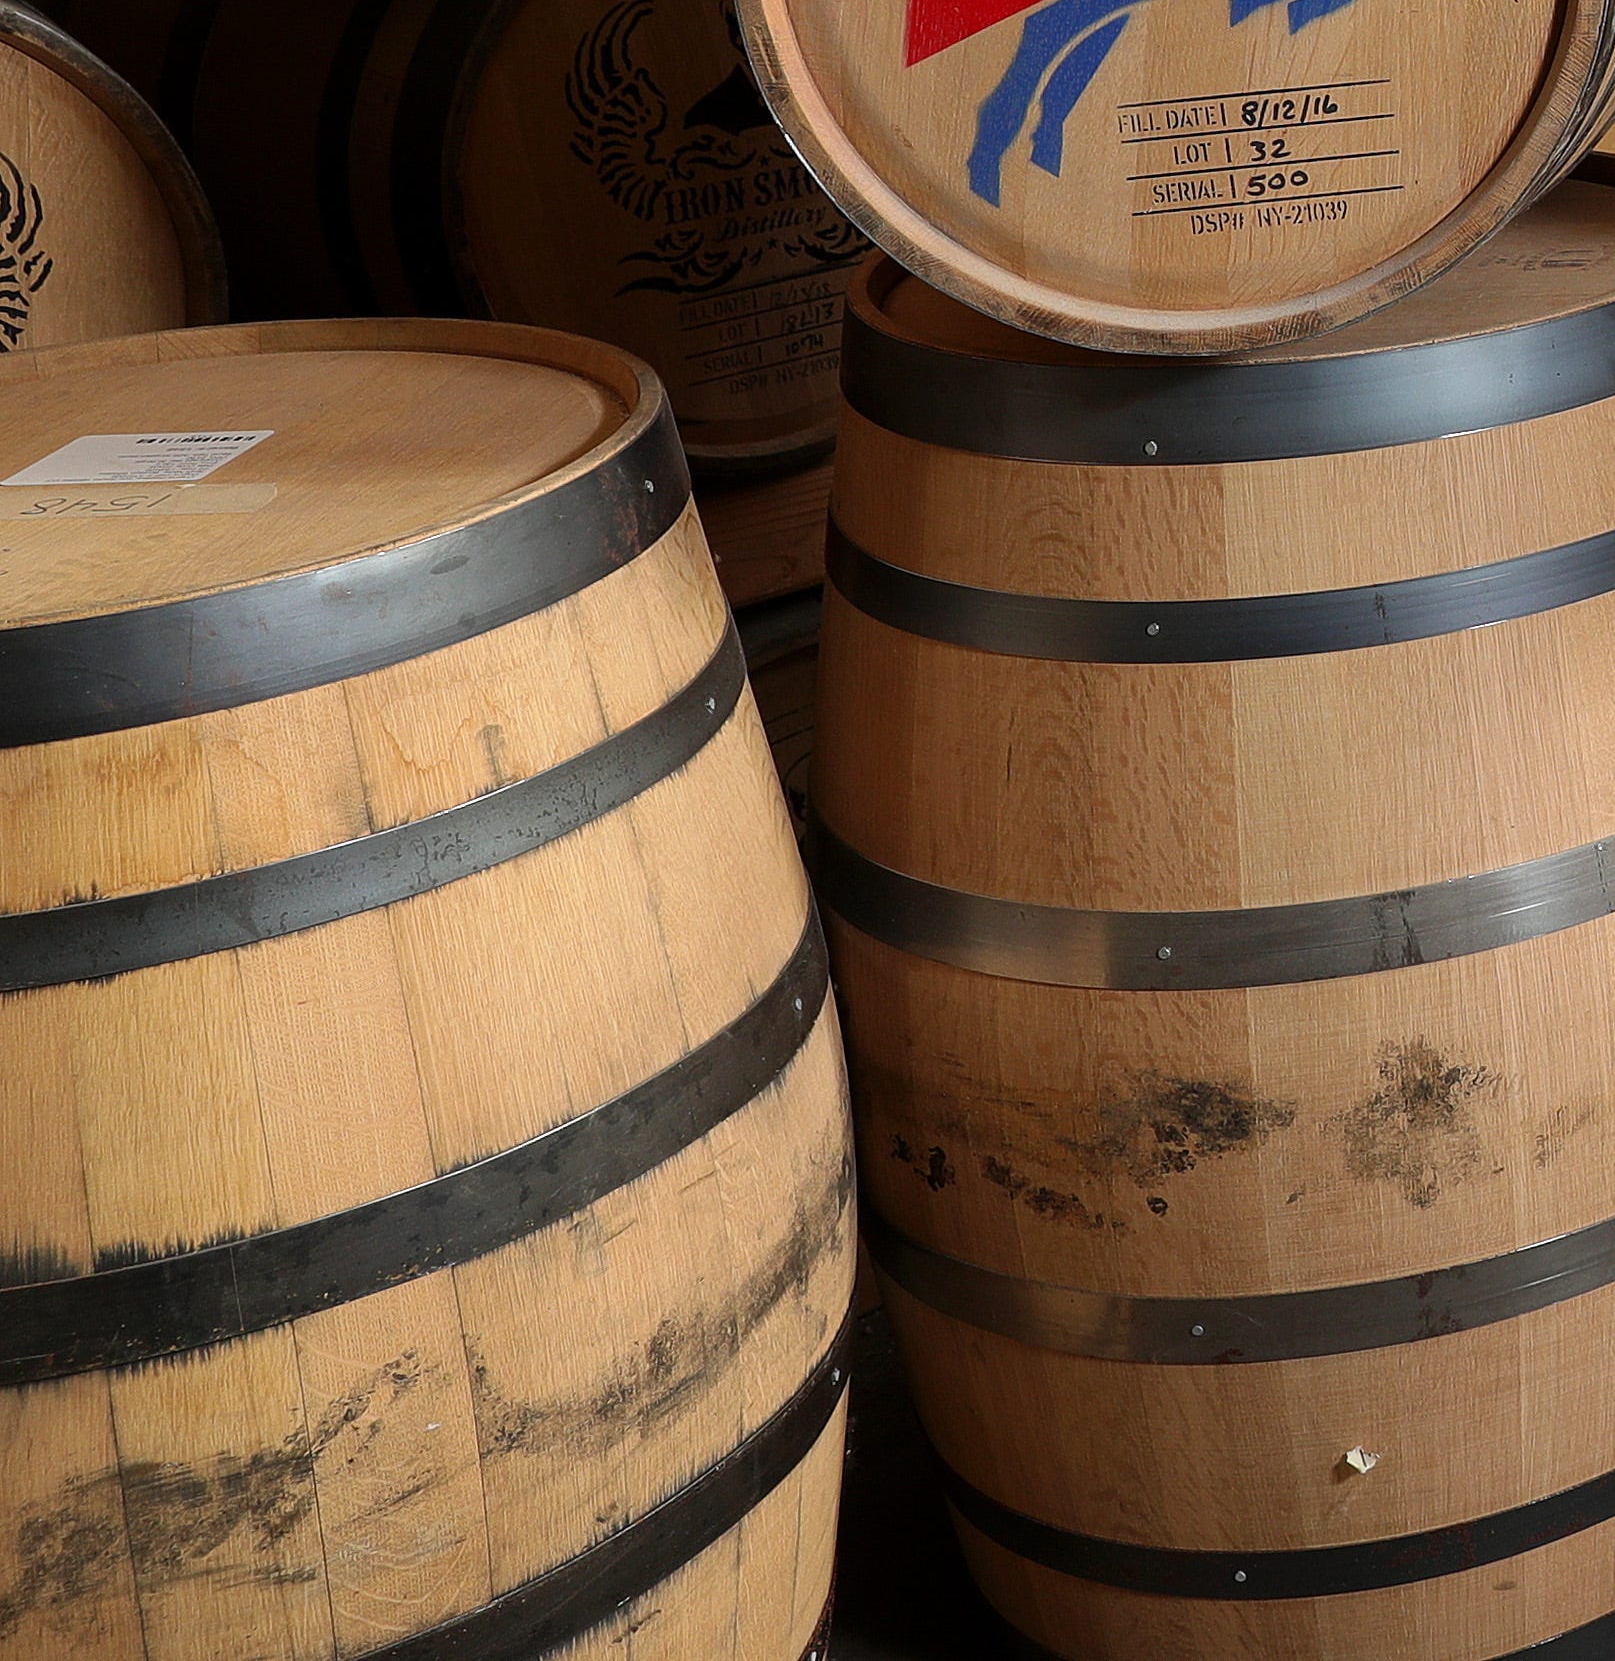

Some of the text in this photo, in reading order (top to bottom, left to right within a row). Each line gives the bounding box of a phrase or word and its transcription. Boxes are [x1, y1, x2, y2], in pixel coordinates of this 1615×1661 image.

[1118, 94, 1339, 133] FILL DATE 8/12/16
[1173, 138, 1291, 165] LOT 32
[662, 177, 744, 225] IRON
[1152, 170, 1309, 204] SERIAL 500
[720, 207, 826, 242] Distillery
[1191, 199, 1348, 235] DSP# NY-21039
[20, 493, 173, 516] 1548
